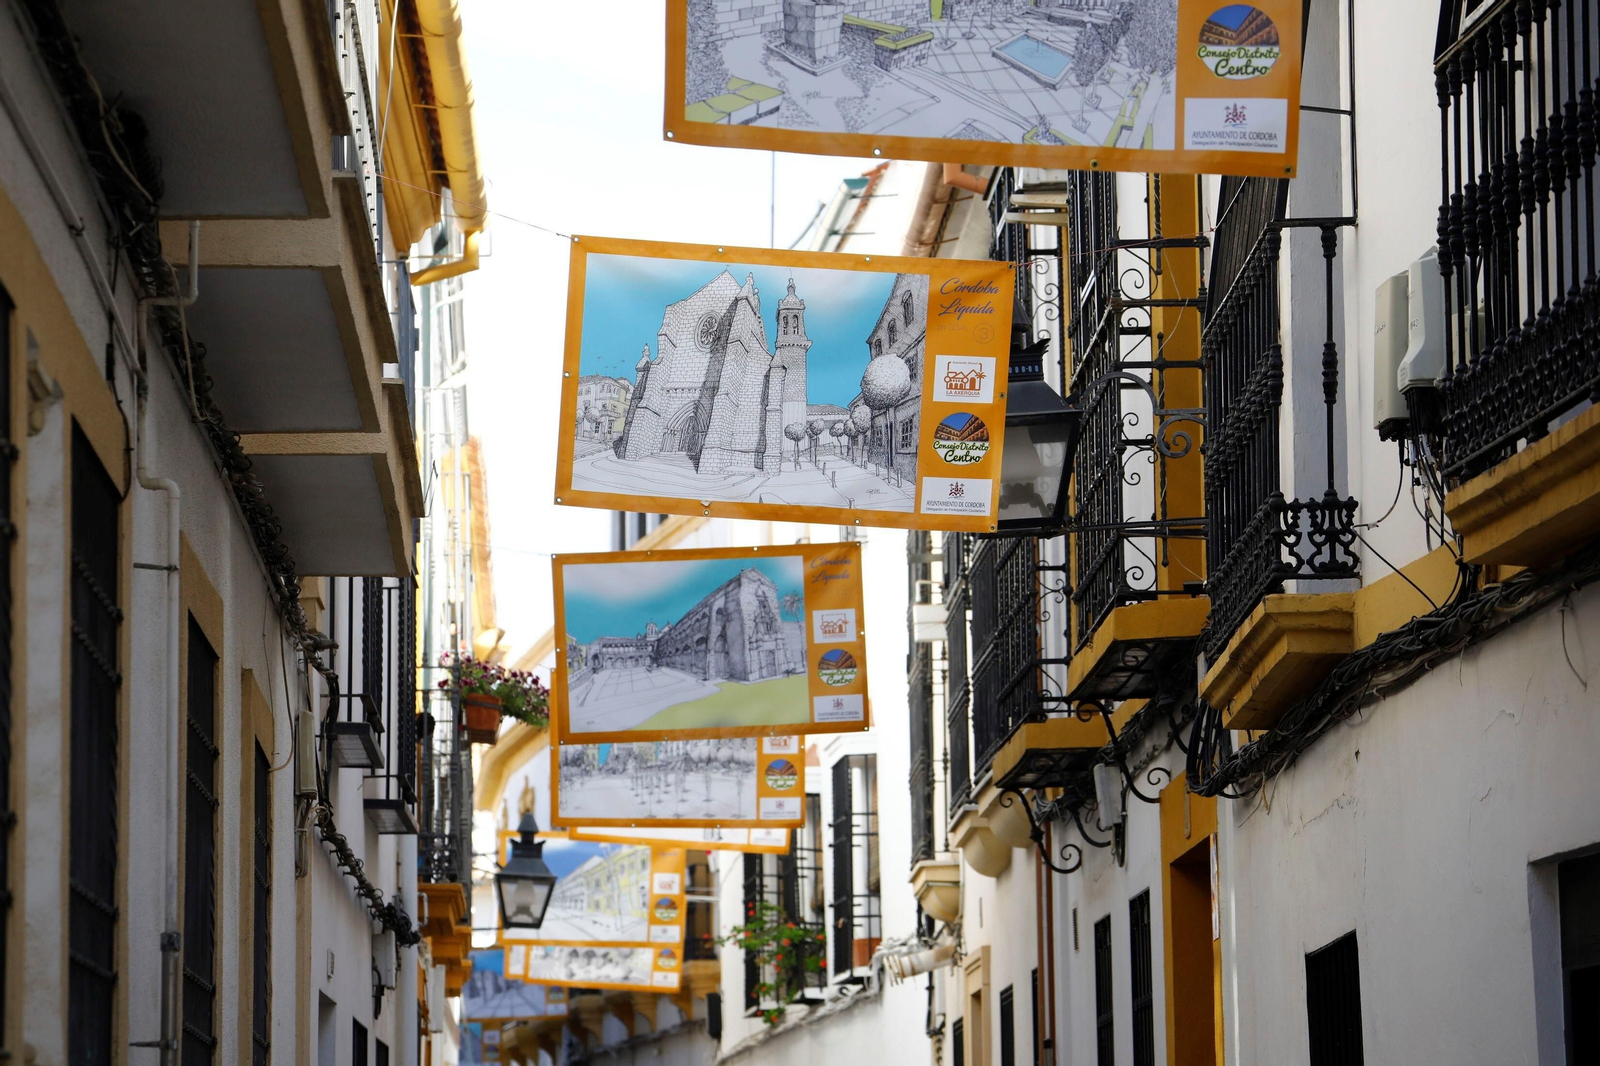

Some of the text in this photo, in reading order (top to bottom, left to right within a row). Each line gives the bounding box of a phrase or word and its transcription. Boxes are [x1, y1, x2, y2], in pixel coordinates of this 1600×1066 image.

[1198, 45, 1280, 61] Consejo Distrito
[1215, 58, 1270, 77] Centro
[1192, 131, 1238, 139] AYUNTAMIENTO
[940, 277, 1000, 295] Córdoba
[979, 327, 988, 339] 3
[933, 440, 989, 452] Consejo Distrito
[944, 450, 982, 462] Centro
[827, 676, 852, 685] Centro
